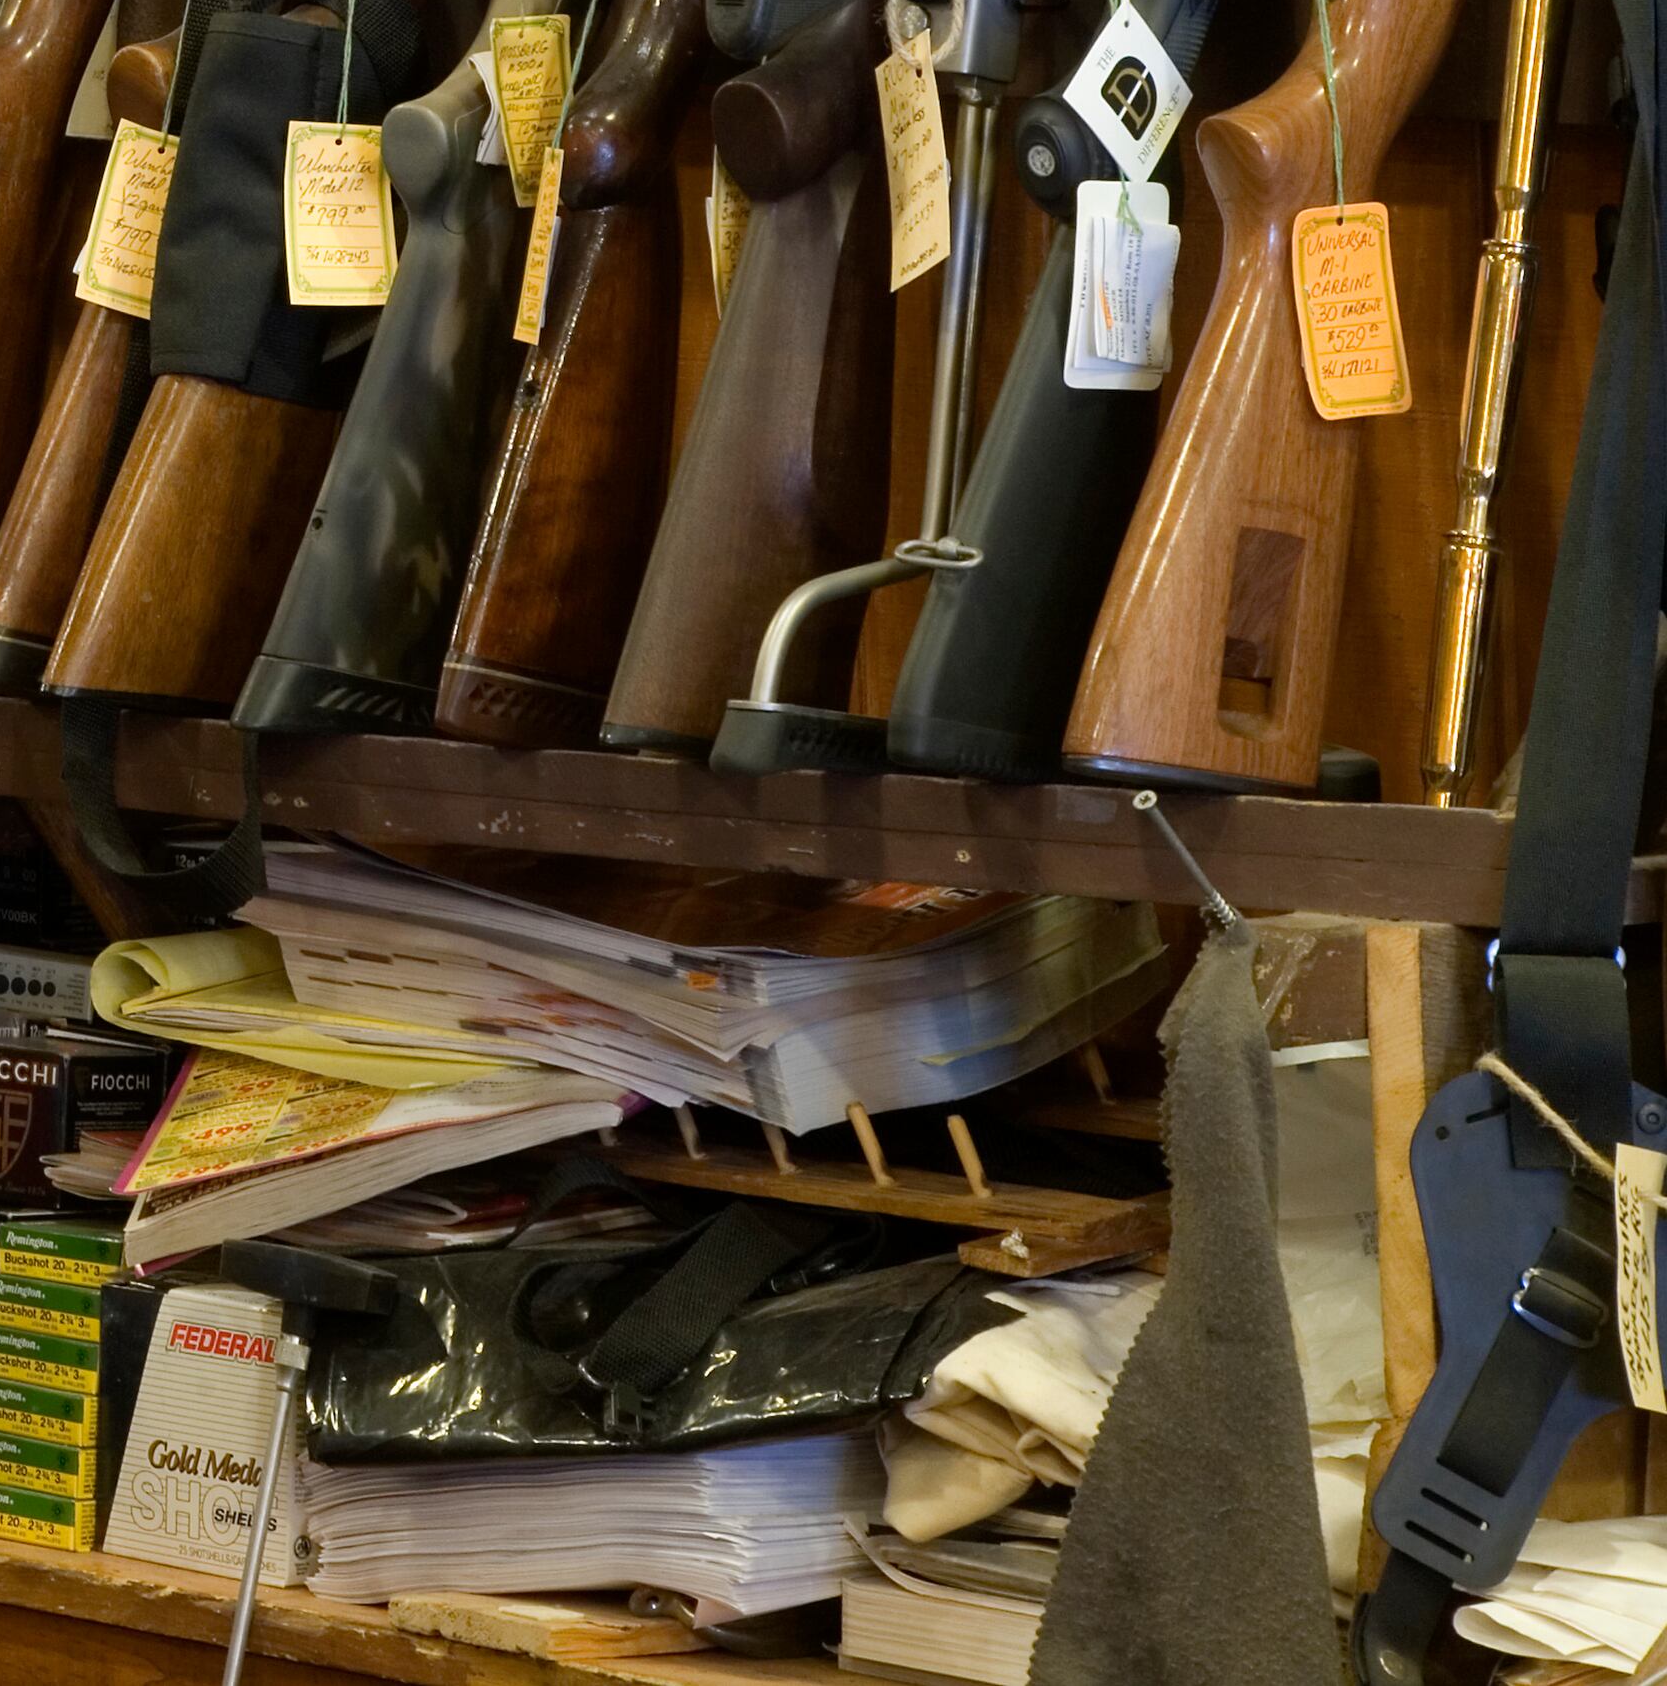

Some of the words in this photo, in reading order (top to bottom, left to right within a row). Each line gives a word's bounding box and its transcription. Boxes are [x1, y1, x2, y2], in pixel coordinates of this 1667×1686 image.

[1095, 45, 1117, 72] THE
[301, 177, 346, 199] Model
[348, 179, 364, 193] 12
[1306, 230, 1376, 257] UNIVERSAL
[1319, 255, 1348, 278] M-1
[1310, 272, 1375, 299] CARBINE
[1341, 300, 1383, 319] CARBINE
[91, 1074, 151, 1092] FIOCCHI
[5, 1230, 57, 1251] Remington
[4, 1251, 50, 1270] Buckshot
[52, 1257, 66, 1271] 20
[39, 1308, 53, 1323] 20
[168, 1321, 277, 1365] FEDERAL
[33, 1359, 47, 1374] 20
[19, 1411, 33, 1426] 20
[15, 1463, 28, 1478] 20
[147, 1439, 199, 1477] Gold
[203, 1449, 264, 1488] Meda
